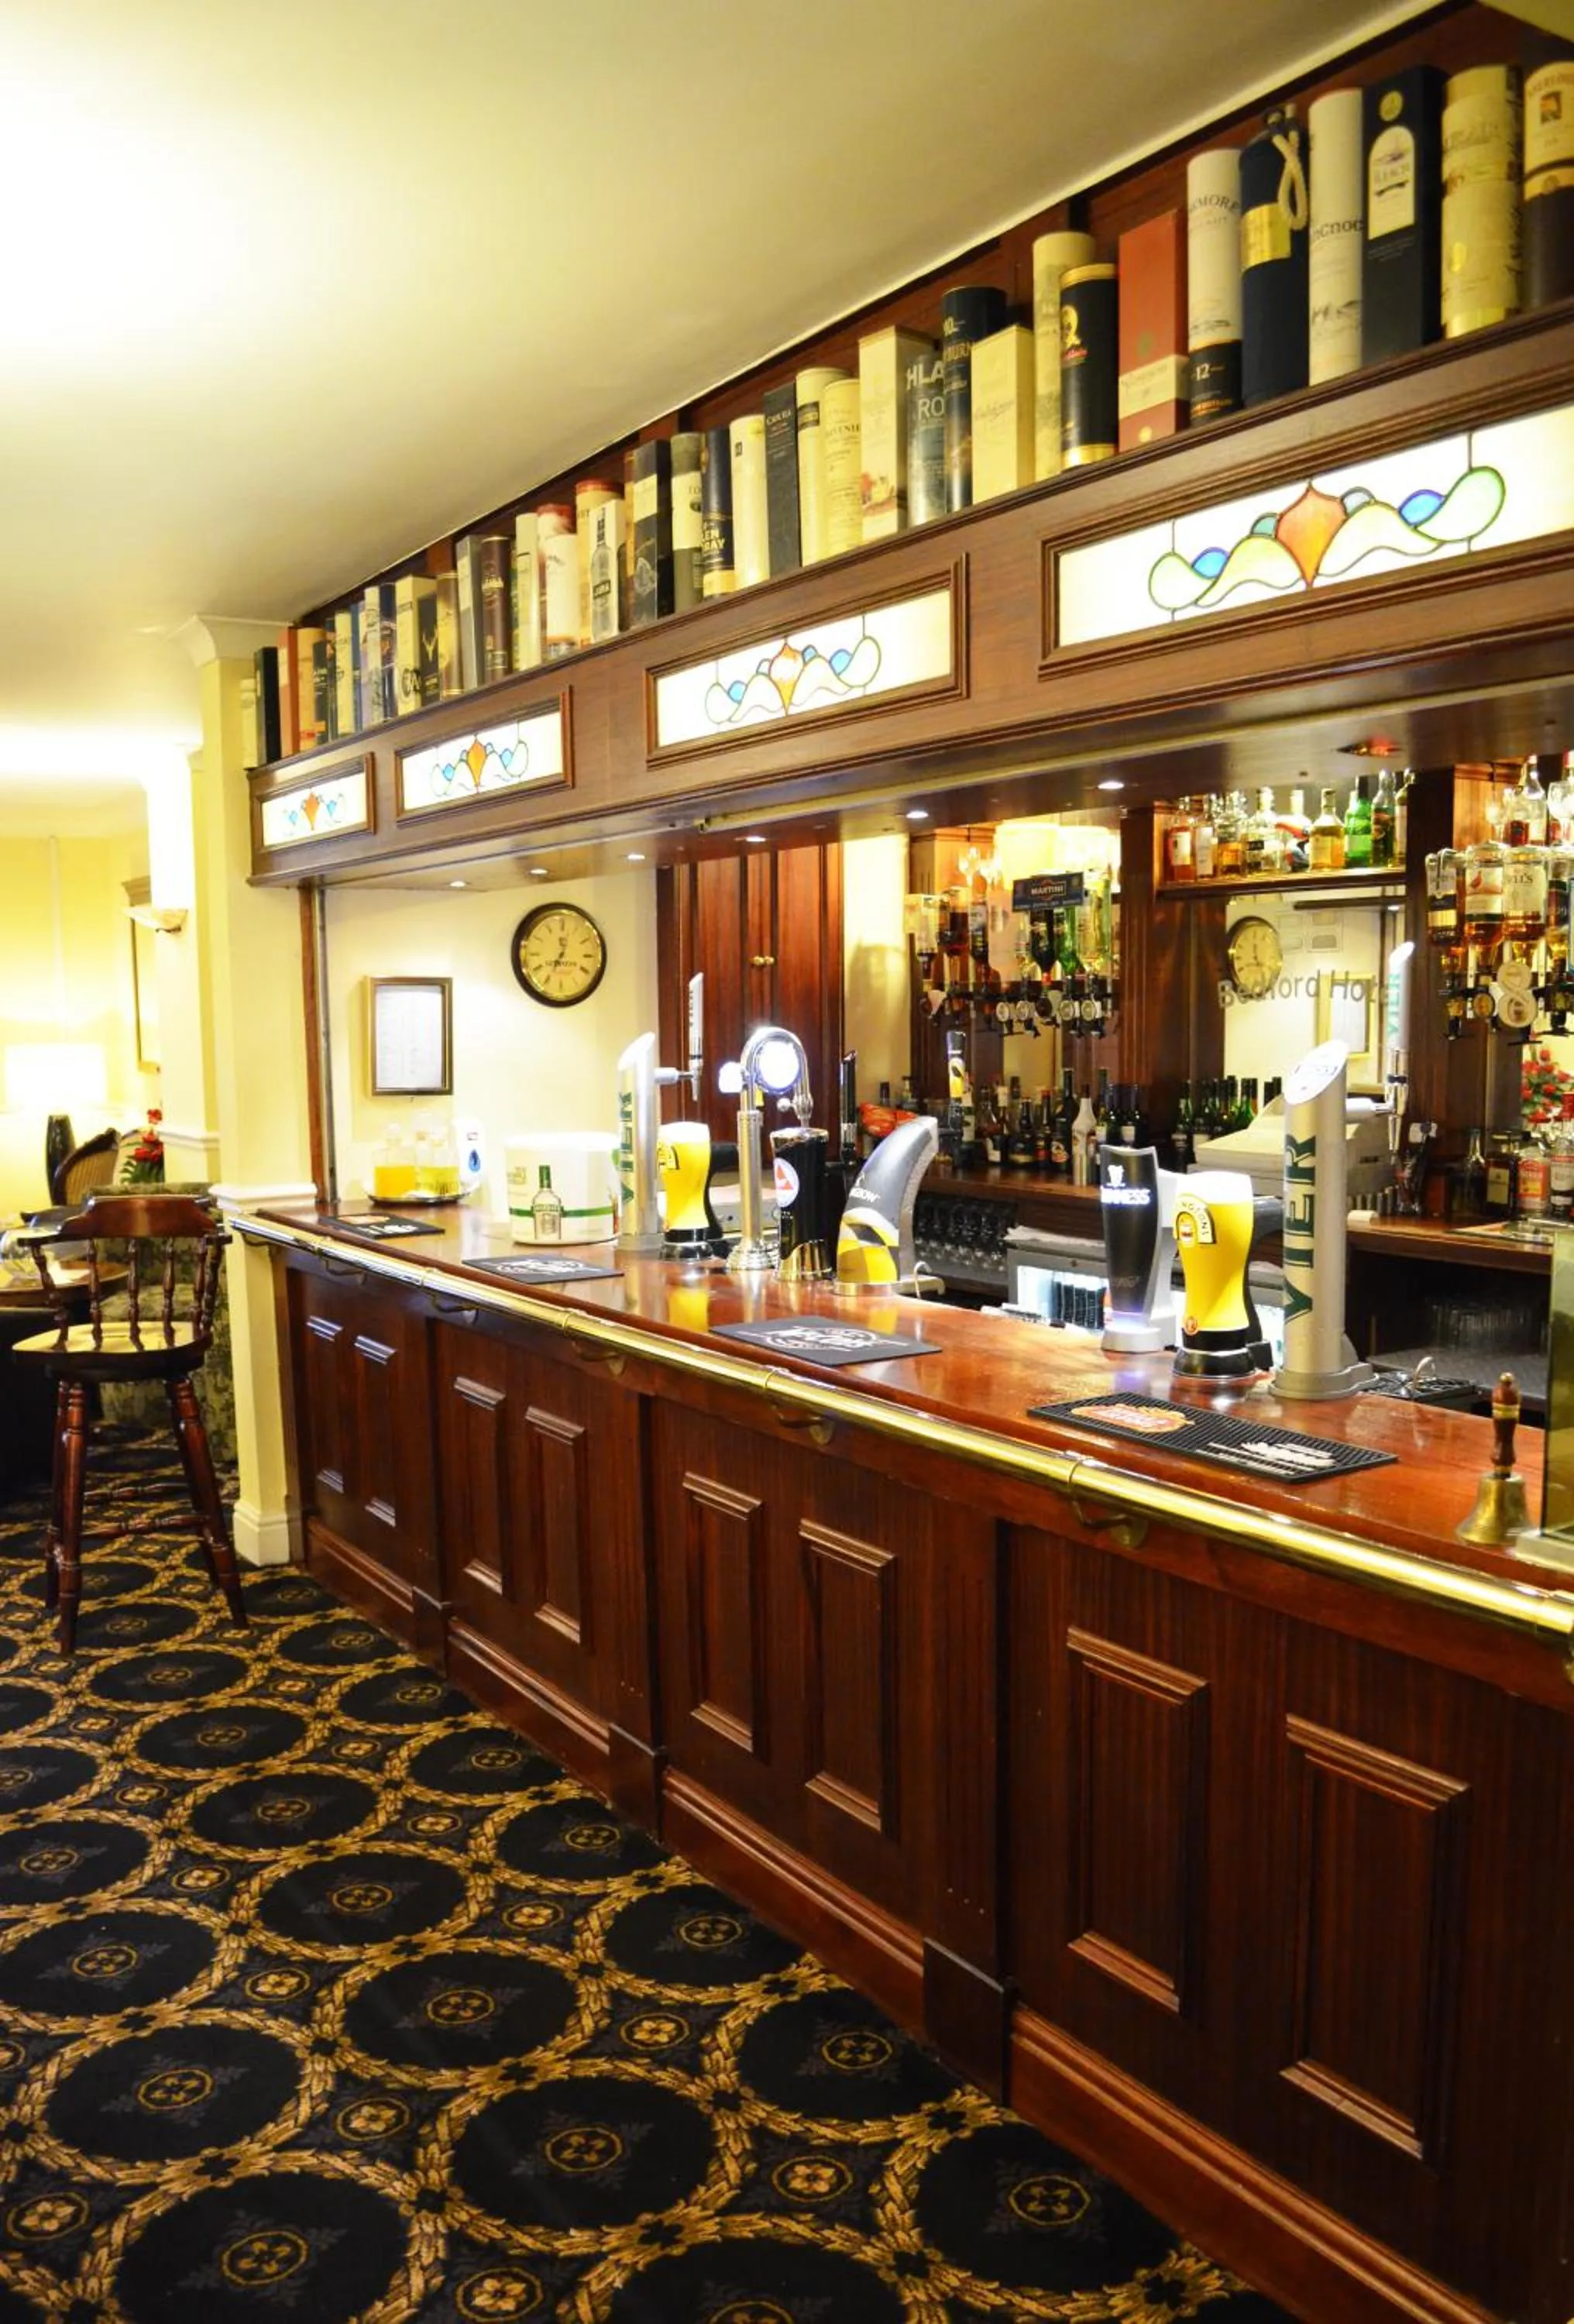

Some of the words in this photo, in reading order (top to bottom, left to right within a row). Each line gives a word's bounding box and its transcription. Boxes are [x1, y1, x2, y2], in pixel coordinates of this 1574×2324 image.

[1195, 363, 1210, 381] 12
[1030, 885, 1064, 896] MARTINI
[1284, 1134, 1315, 1323] VIER
